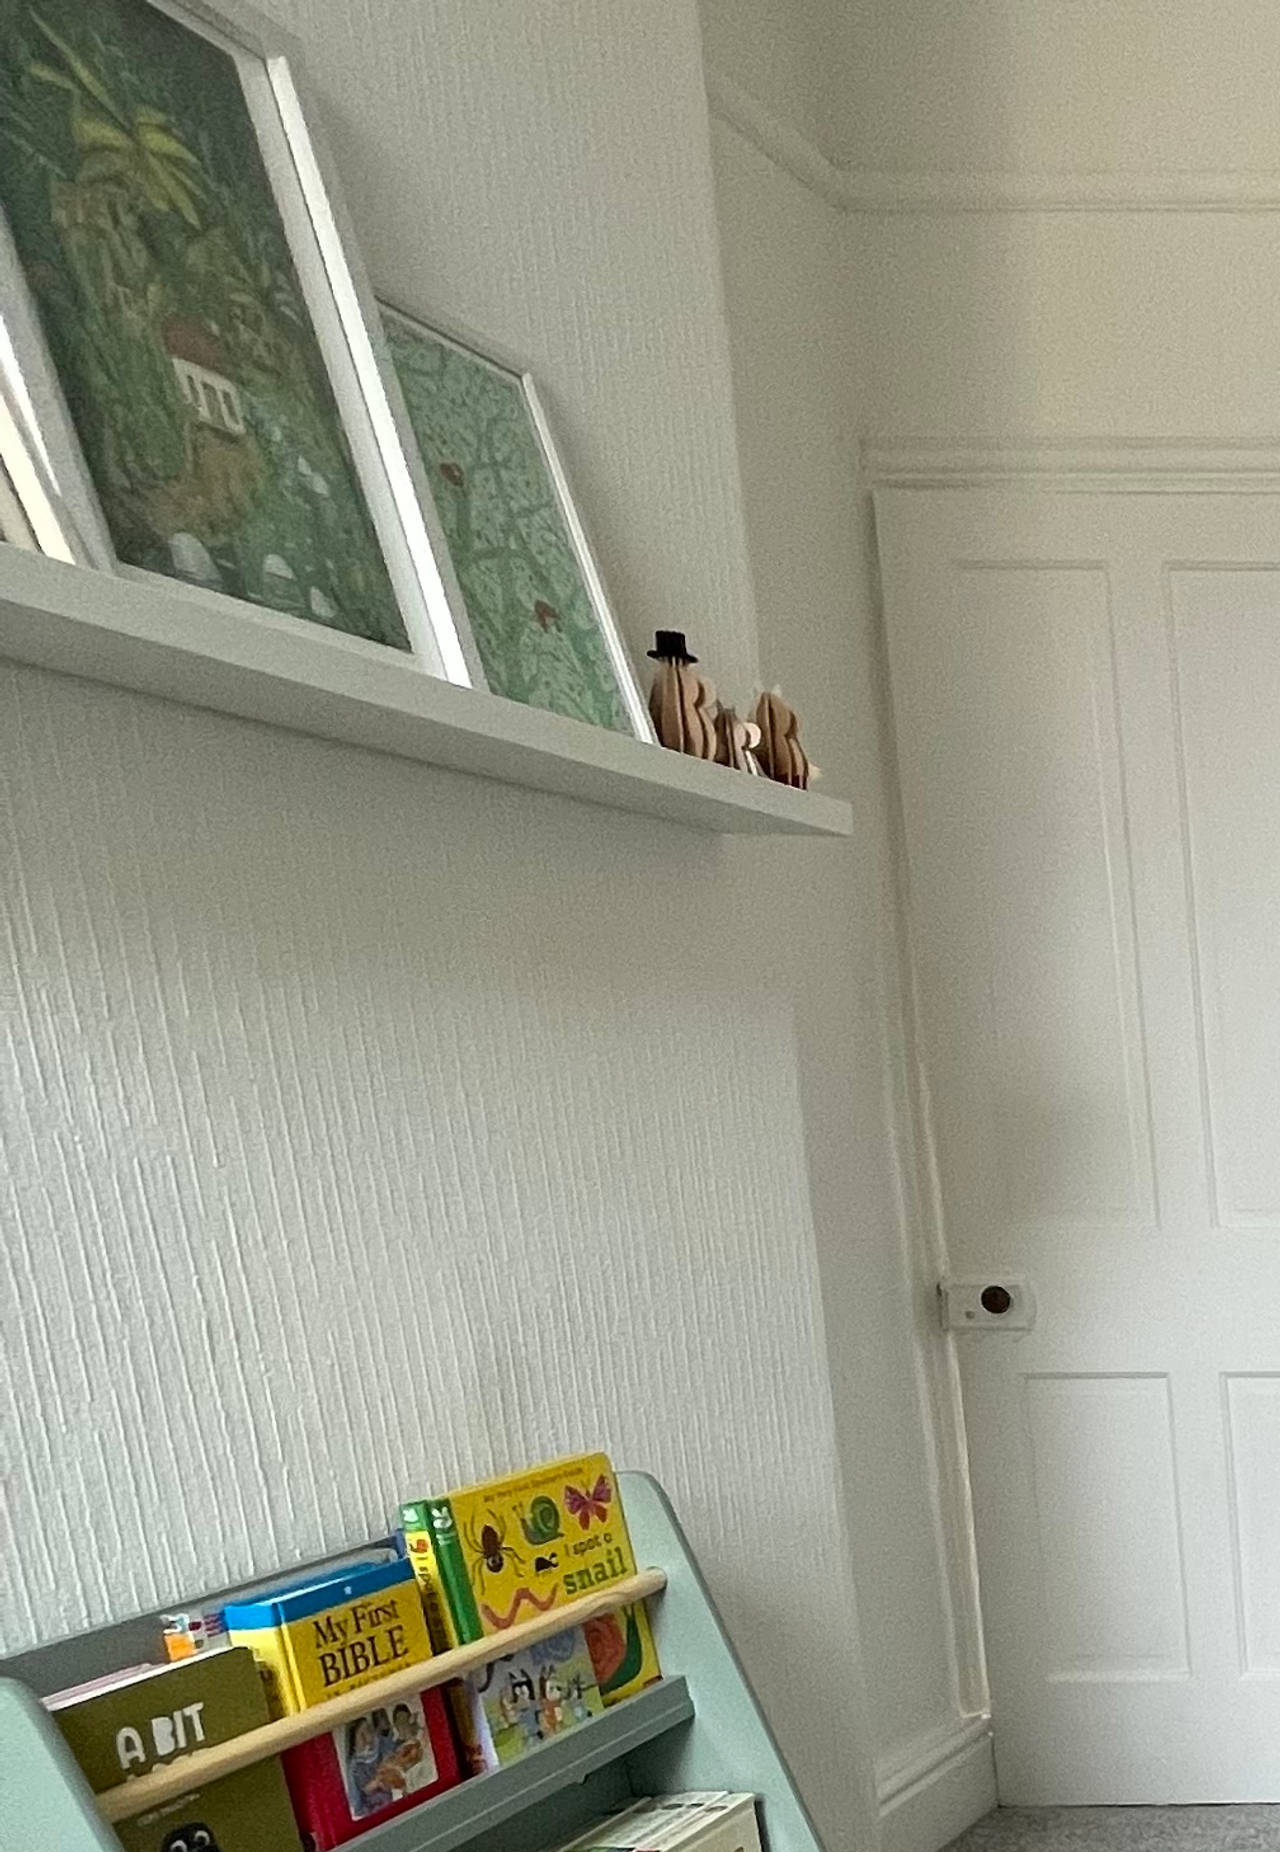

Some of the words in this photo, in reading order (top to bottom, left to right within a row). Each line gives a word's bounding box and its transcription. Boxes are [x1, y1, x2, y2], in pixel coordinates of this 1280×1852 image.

[563, 1546, 627, 1595] snail
[313, 1614, 350, 1648] My
[352, 1598, 401, 1635] First
[319, 1625, 408, 1688] BIBLE
[116, 1726, 146, 1770] A
[151, 1702, 205, 1757] BIT
